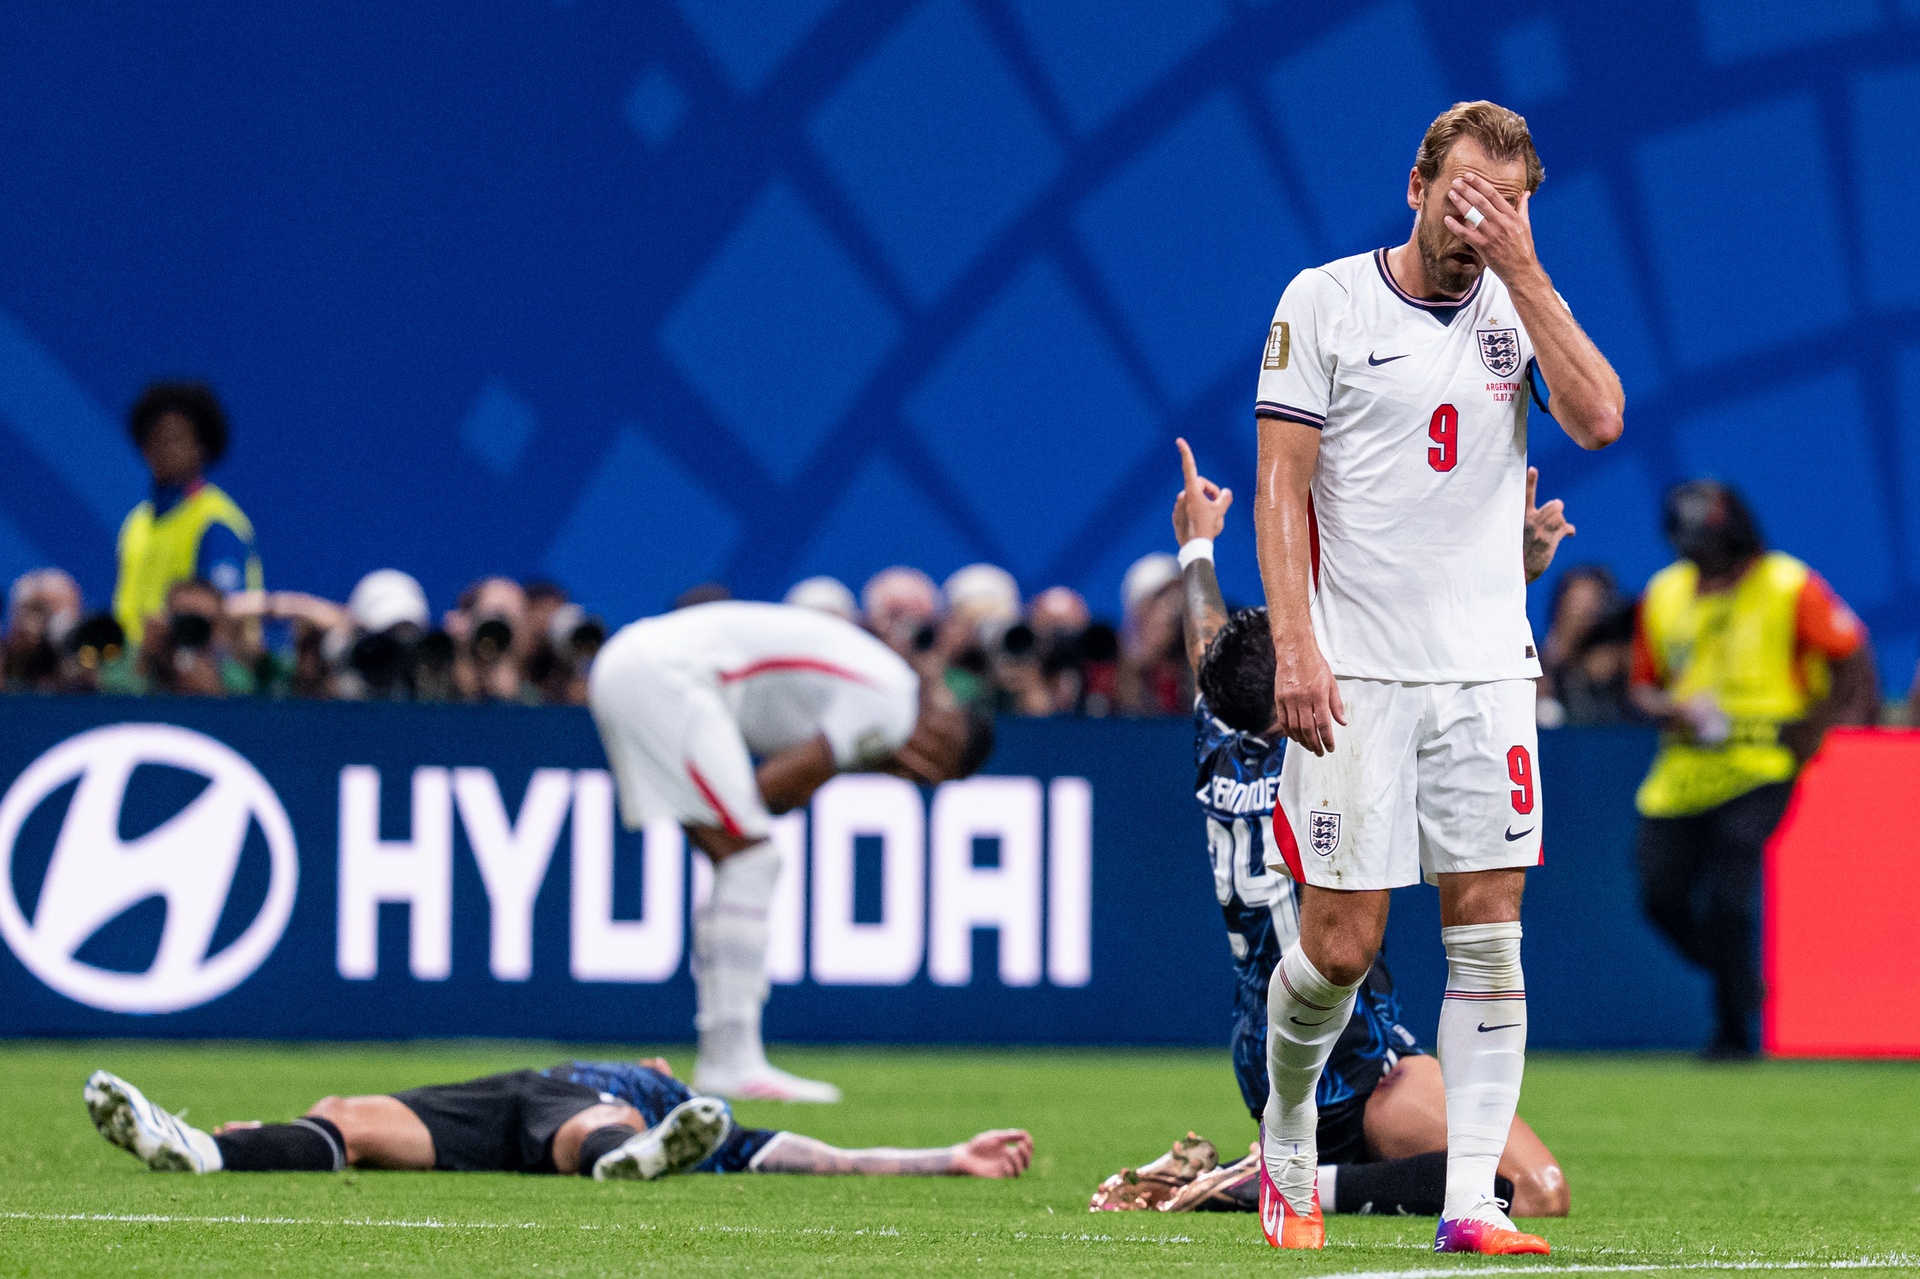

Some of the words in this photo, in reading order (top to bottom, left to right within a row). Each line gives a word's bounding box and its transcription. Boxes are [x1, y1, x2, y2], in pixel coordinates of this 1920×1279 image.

[1485, 382, 1521, 392] ARGENTINA
[1427, 403, 1459, 472] 9
[1506, 745, 1535, 815] 9
